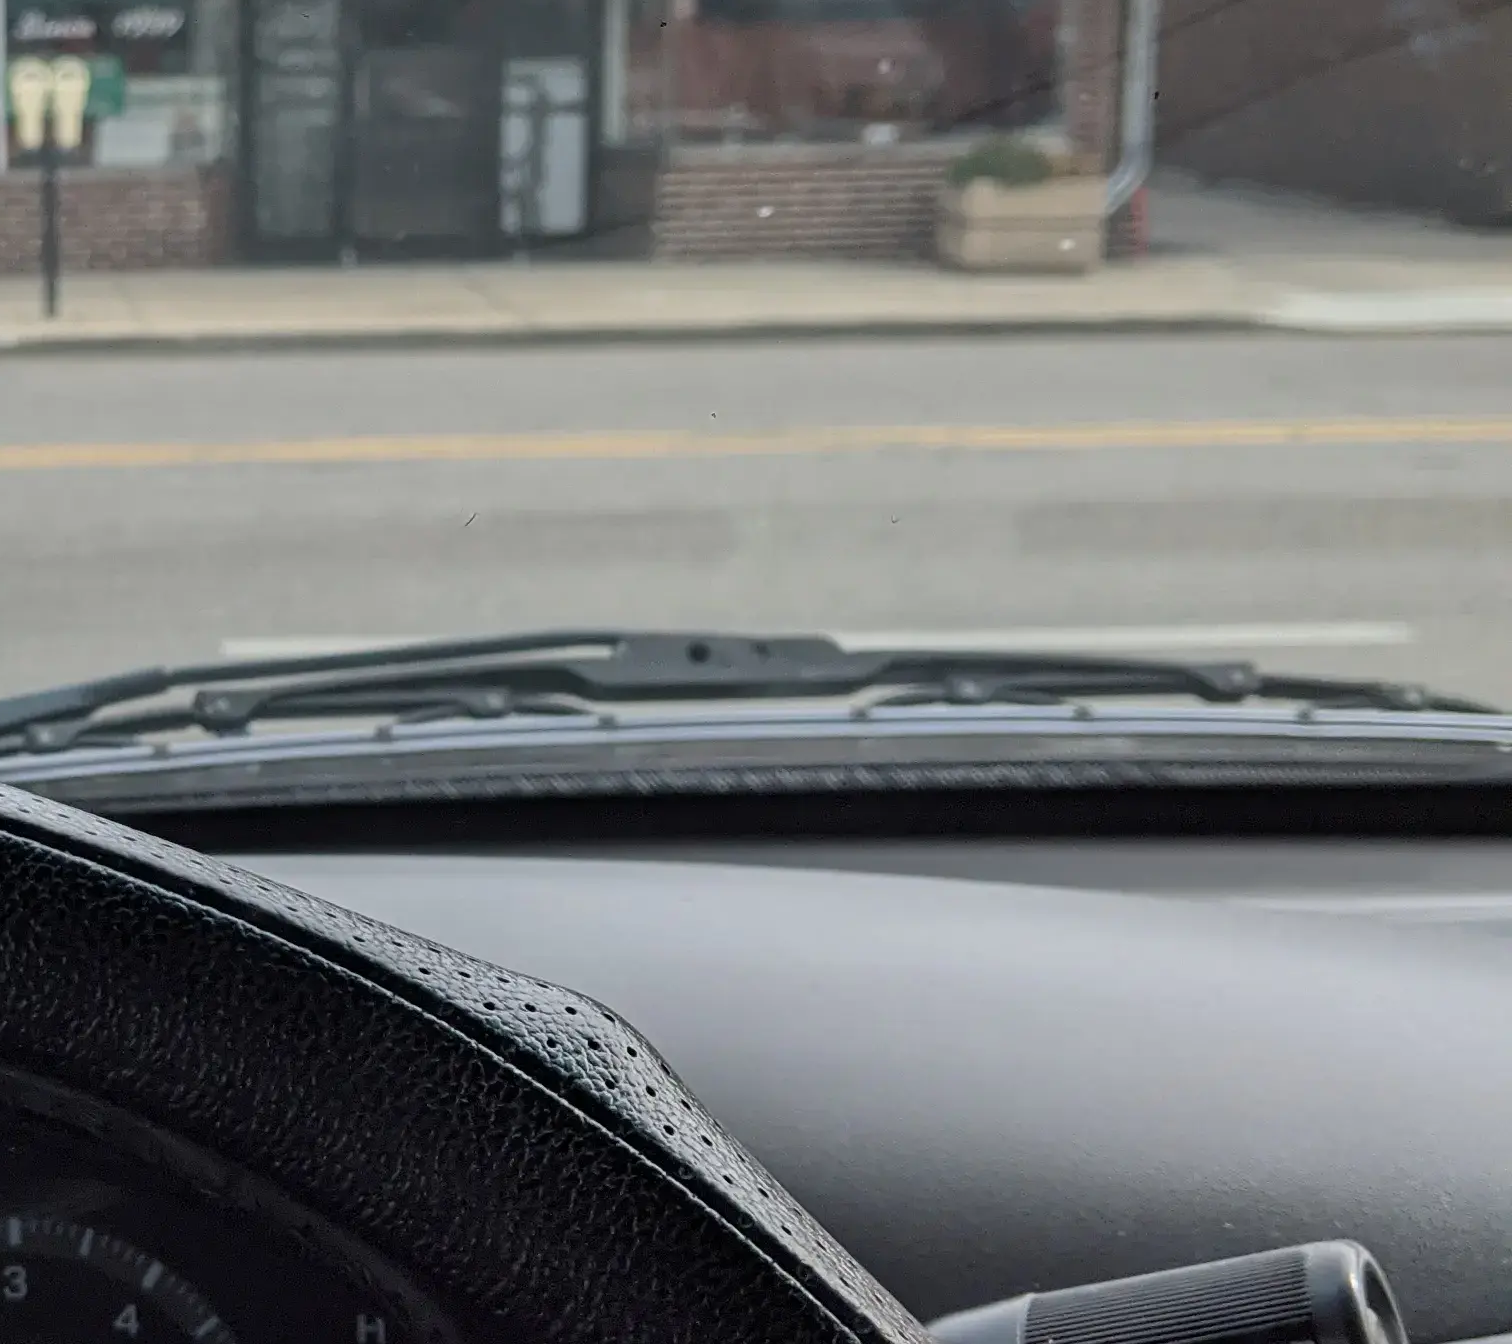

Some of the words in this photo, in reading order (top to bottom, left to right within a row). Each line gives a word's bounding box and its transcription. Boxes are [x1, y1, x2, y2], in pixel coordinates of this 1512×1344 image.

[2, 1264, 28, 1300] 3
[113, 1303, 140, 1335] 4
[356, 1314, 386, 1344] H
